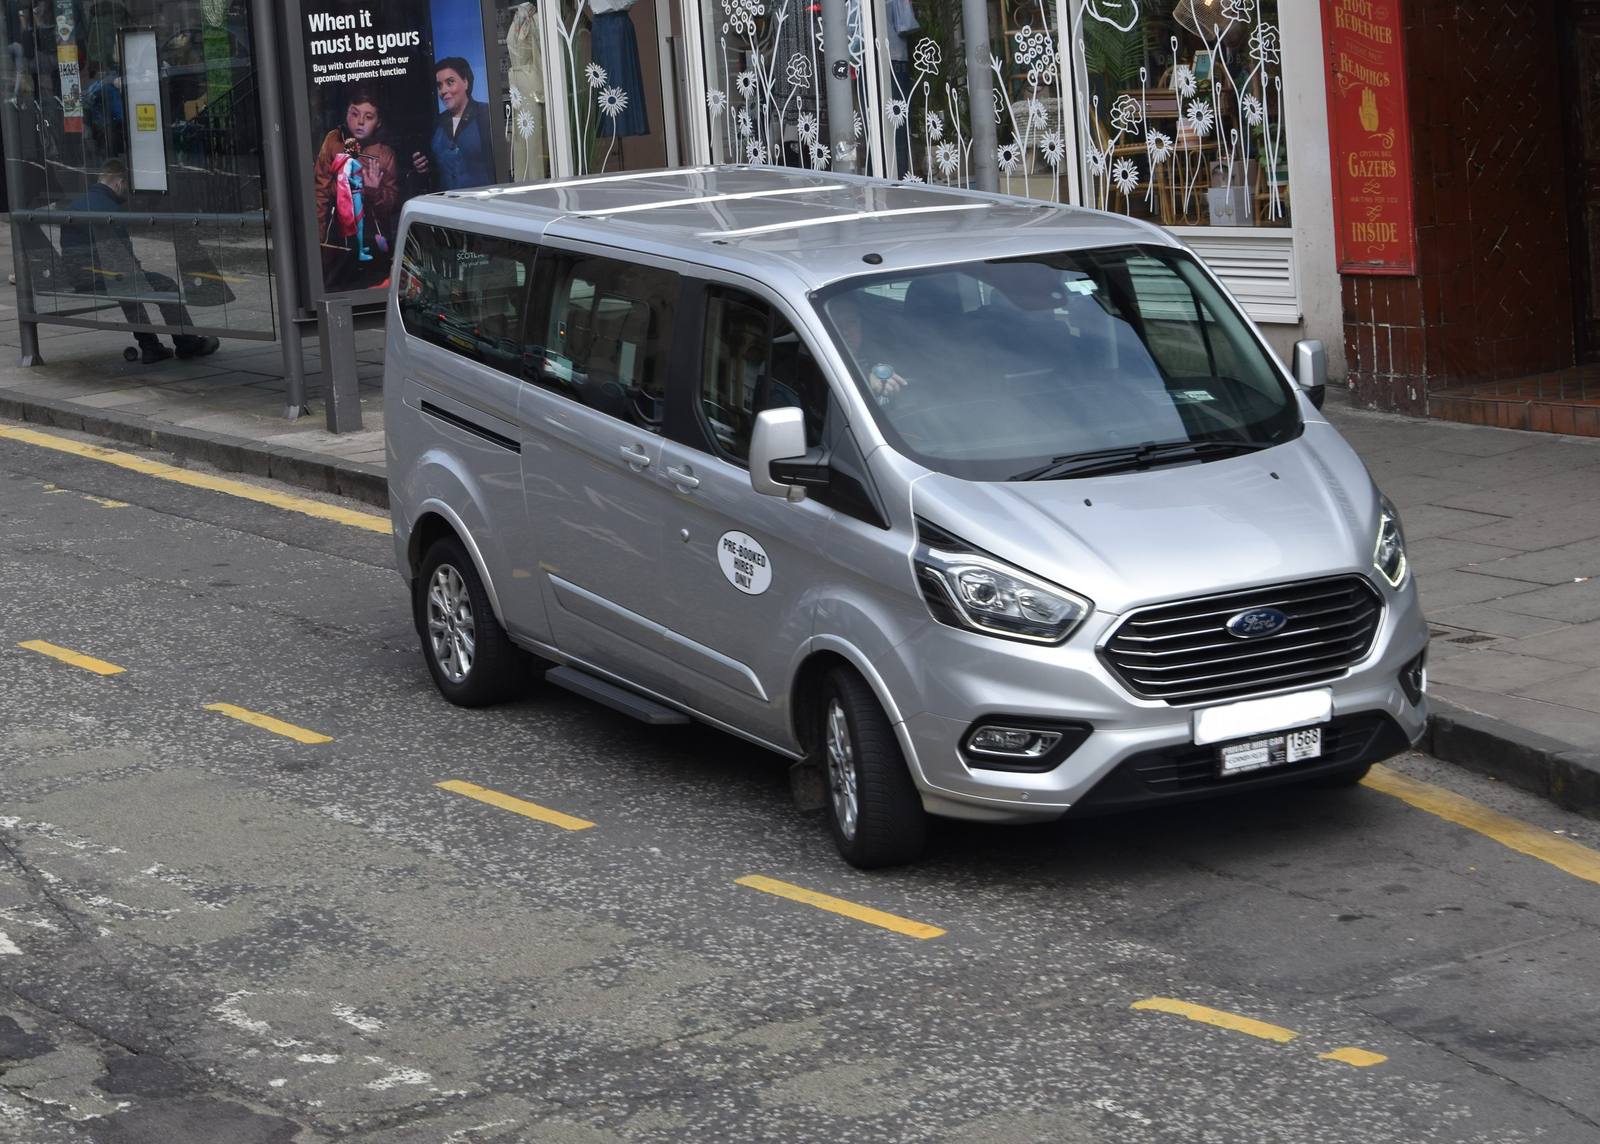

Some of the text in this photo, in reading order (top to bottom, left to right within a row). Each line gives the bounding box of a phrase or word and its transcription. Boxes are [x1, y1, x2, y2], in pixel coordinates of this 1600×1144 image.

[308, 10, 372, 32] When it
[1335, 6, 1393, 44] REDEEMER
[311, 30, 420, 55] must be yours
[313, 56, 409, 74] Buy with confidence with our
[1340, 53, 1392, 87] READINGS
[314, 67, 407, 85] upcoming payments function
[1348, 152, 1397, 178] GAZERS
[1352, 222, 1399, 242] INSIDE
[723, 538, 766, 568] PRE-BOOKED
[734, 556, 754, 576] HIRES
[735, 571, 752, 589] ONLY
[1250, 740, 1268, 750] HIRE
[1290, 729, 1319, 749] 1568
